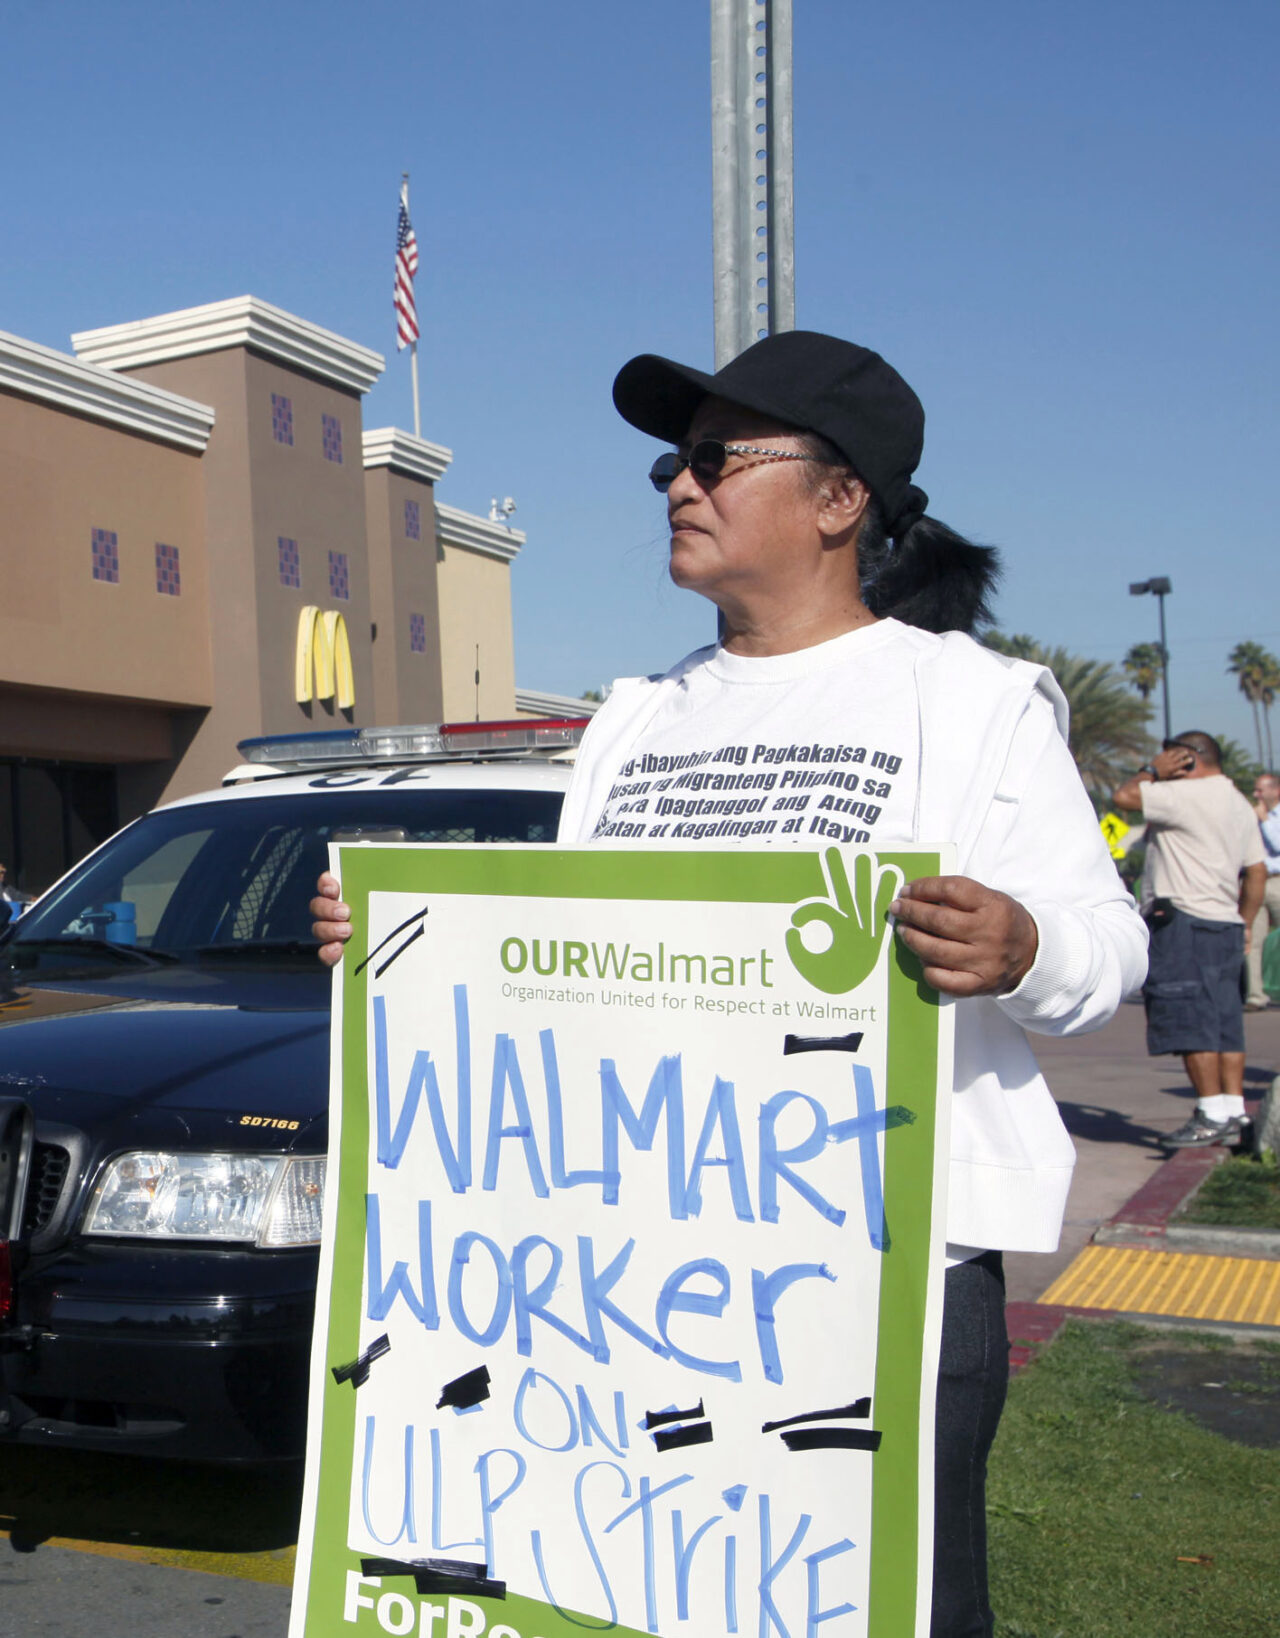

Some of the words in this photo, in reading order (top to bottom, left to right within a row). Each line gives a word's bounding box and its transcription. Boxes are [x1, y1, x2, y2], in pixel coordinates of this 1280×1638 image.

[712, 746, 748, 766] ang
[752, 744, 867, 764] Pagkakaisa
[870, 751, 903, 775] ng
[672, 771, 778, 792] Migranteng
[779, 769, 860, 791] Pilipino
[862, 779, 892, 799] sa
[654, 795, 768, 818] Ipagtanggol
[771, 794, 811, 812] ang
[817, 794, 883, 826] Ating
[648, 822, 671, 838] at
[671, 819, 778, 840] Kagalingan
[781, 816, 805, 834] at
[500, 937, 774, 988] OURWalmart
[501, 982, 596, 1004] Organization
[601, 985, 655, 1008] United
[661, 992, 687, 1010] for
[694, 995, 766, 1017] Respect
[772, 1002, 791, 1017] at
[796, 1001, 877, 1022] Walmart
[239, 1115, 300, 1130] SD7166
[362, 1415, 527, 1578] ULP
